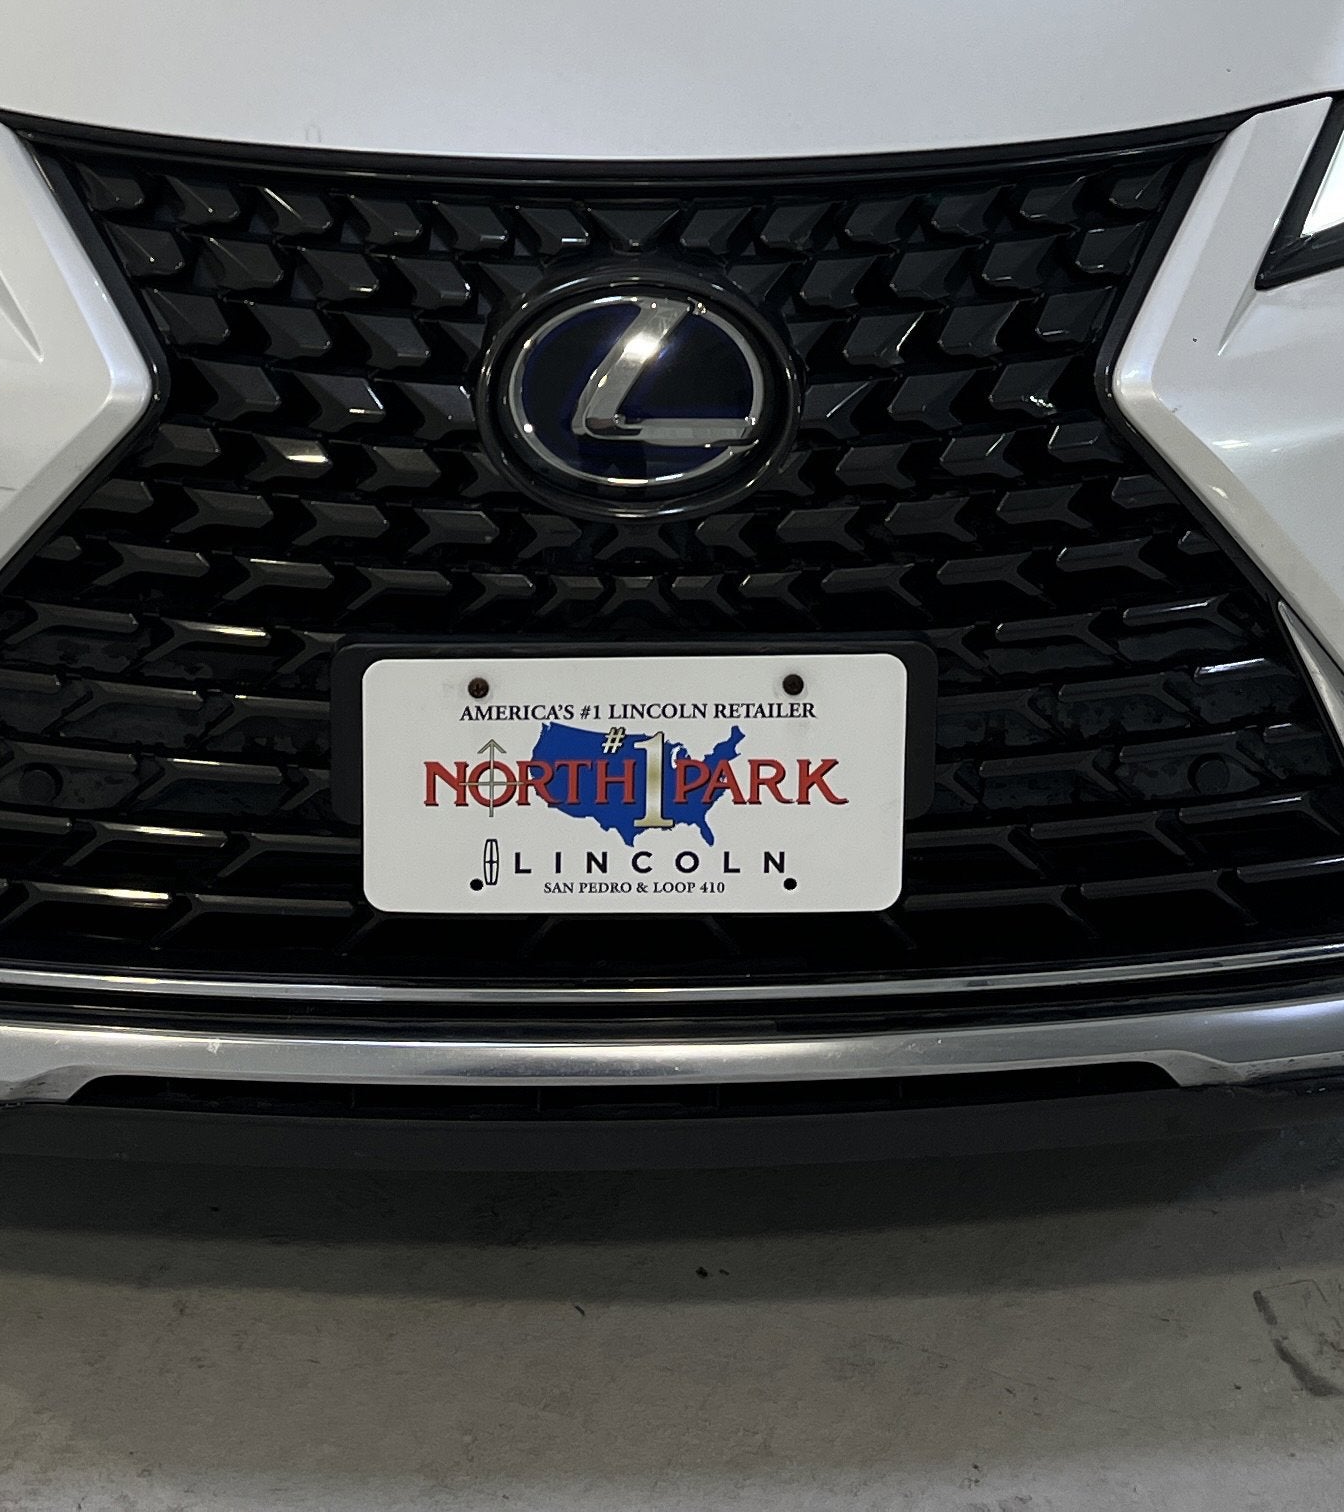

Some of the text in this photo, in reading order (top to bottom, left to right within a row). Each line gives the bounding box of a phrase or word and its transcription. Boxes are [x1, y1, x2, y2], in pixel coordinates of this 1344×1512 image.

[459, 702, 817, 721] AMERICA'S #1 LINCOLN RETAILER
[423, 759, 849, 807] NORTH PARK
[514, 850, 786, 875] LINCOLN
[543, 881, 726, 894] SAN PEDRO & LOOP 410
